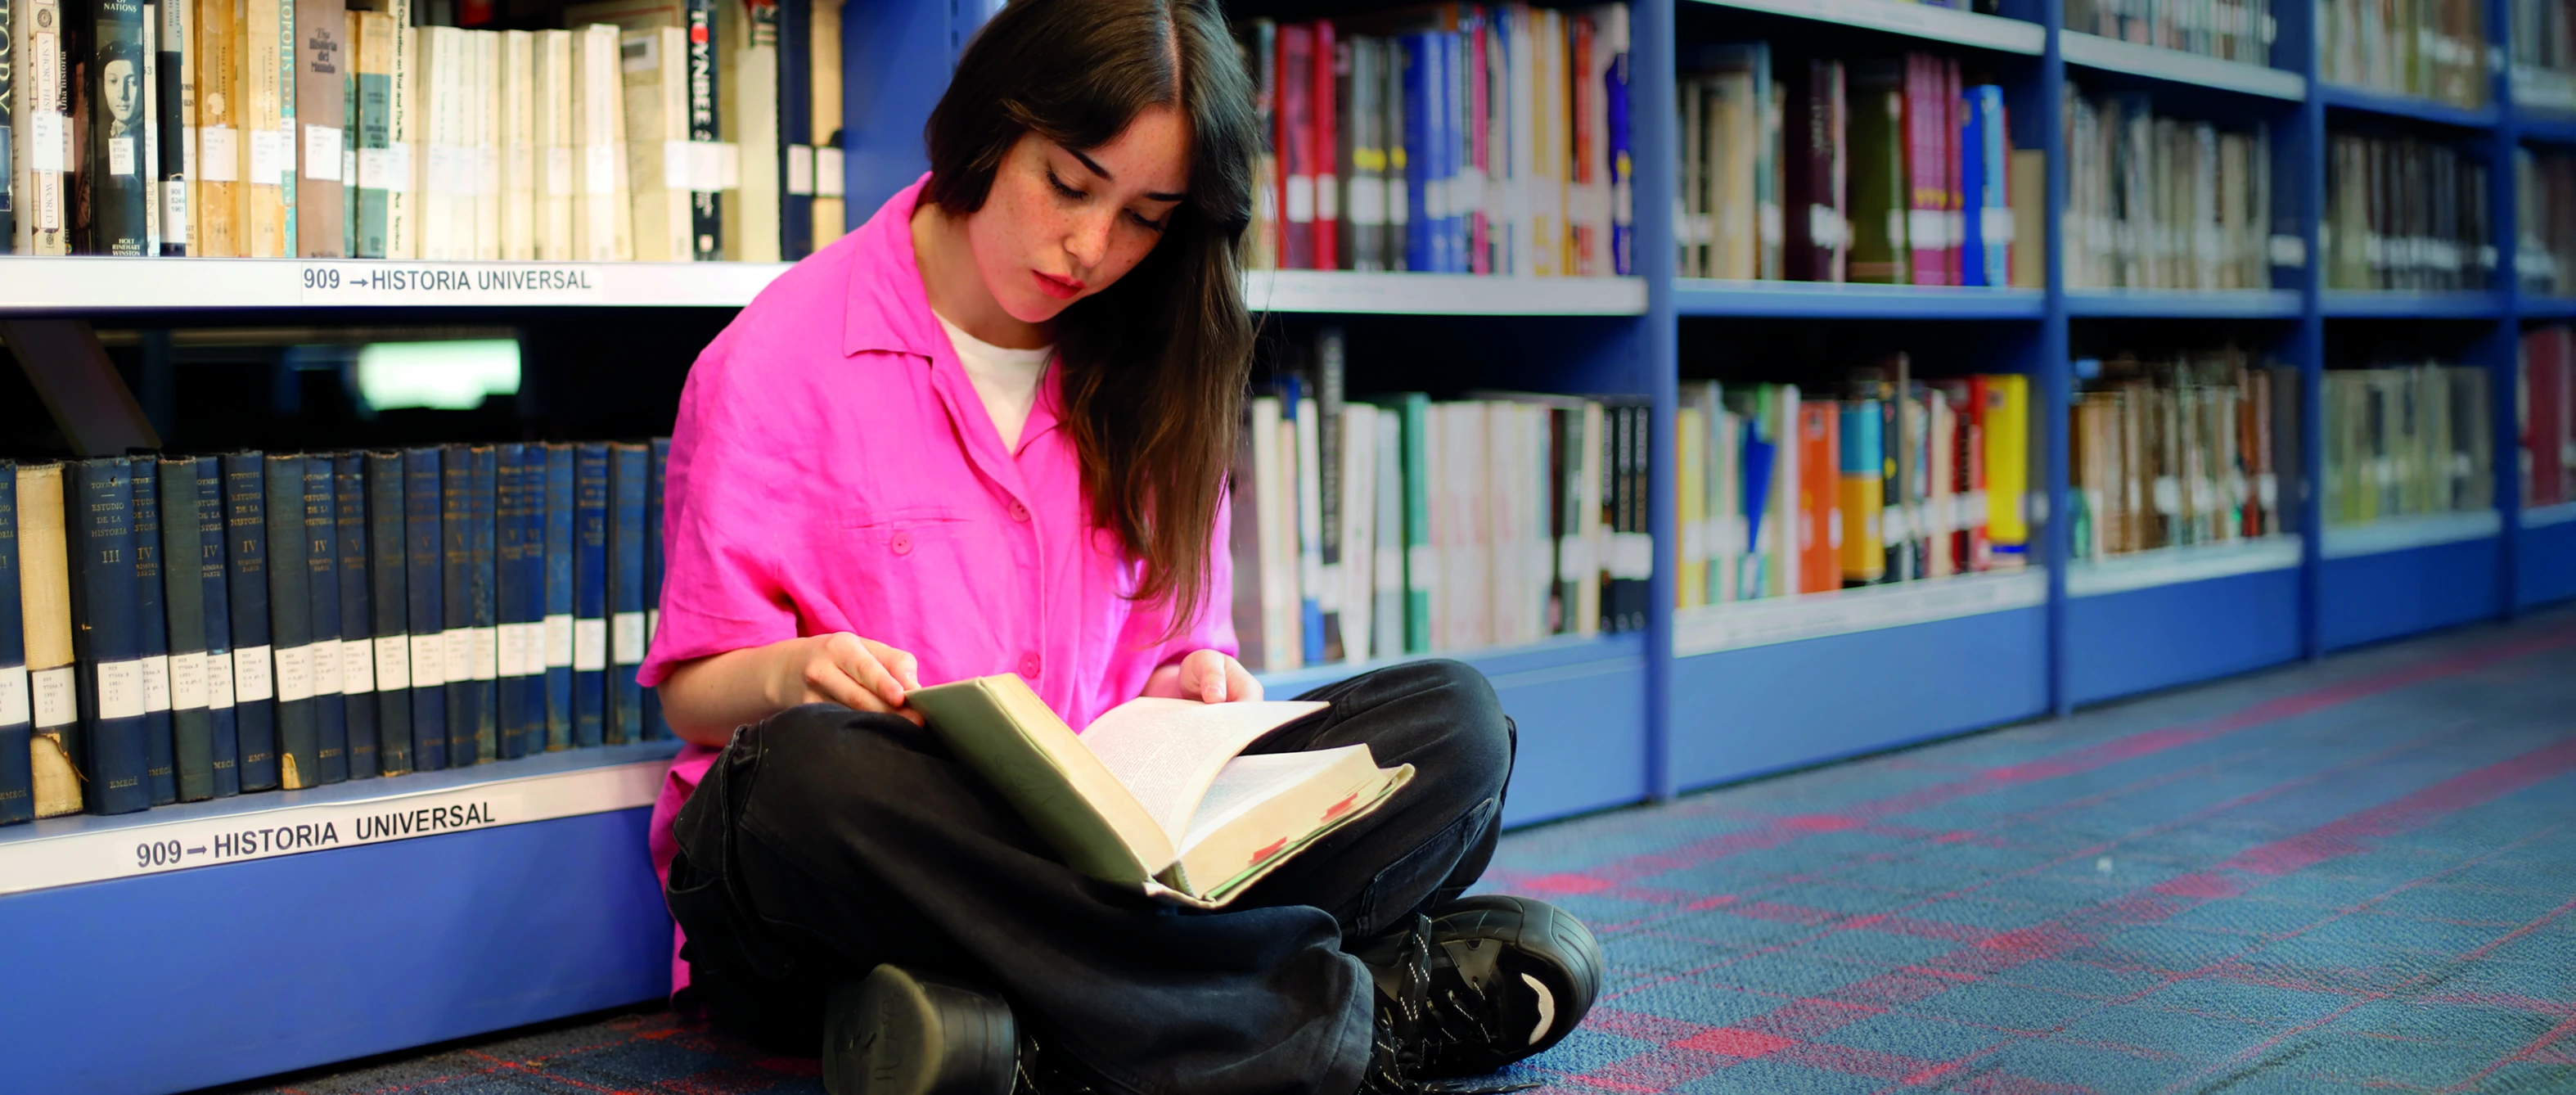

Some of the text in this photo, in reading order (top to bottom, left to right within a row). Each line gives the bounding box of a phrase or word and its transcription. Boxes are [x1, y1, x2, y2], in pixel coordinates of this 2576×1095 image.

[103, 2, 137, 13] NATIONS
[45, 182, 54, 223] WORLD
[304, 268, 592, 291] 909 HISTORIA UNIVERSAL
[92, 502, 125, 511] ESTUDIO
[91, 527, 128, 538] HISTORIA
[204, 544, 218, 557] IV
[243, 539, 257, 552] IV
[313, 539, 327, 552] IV
[101, 549, 120, 563] III
[137, 547, 153, 561] IV
[110, 777, 137, 789] EMECÉ
[137, 801, 496, 867] 909 HISTORIA UNIVERSAL
